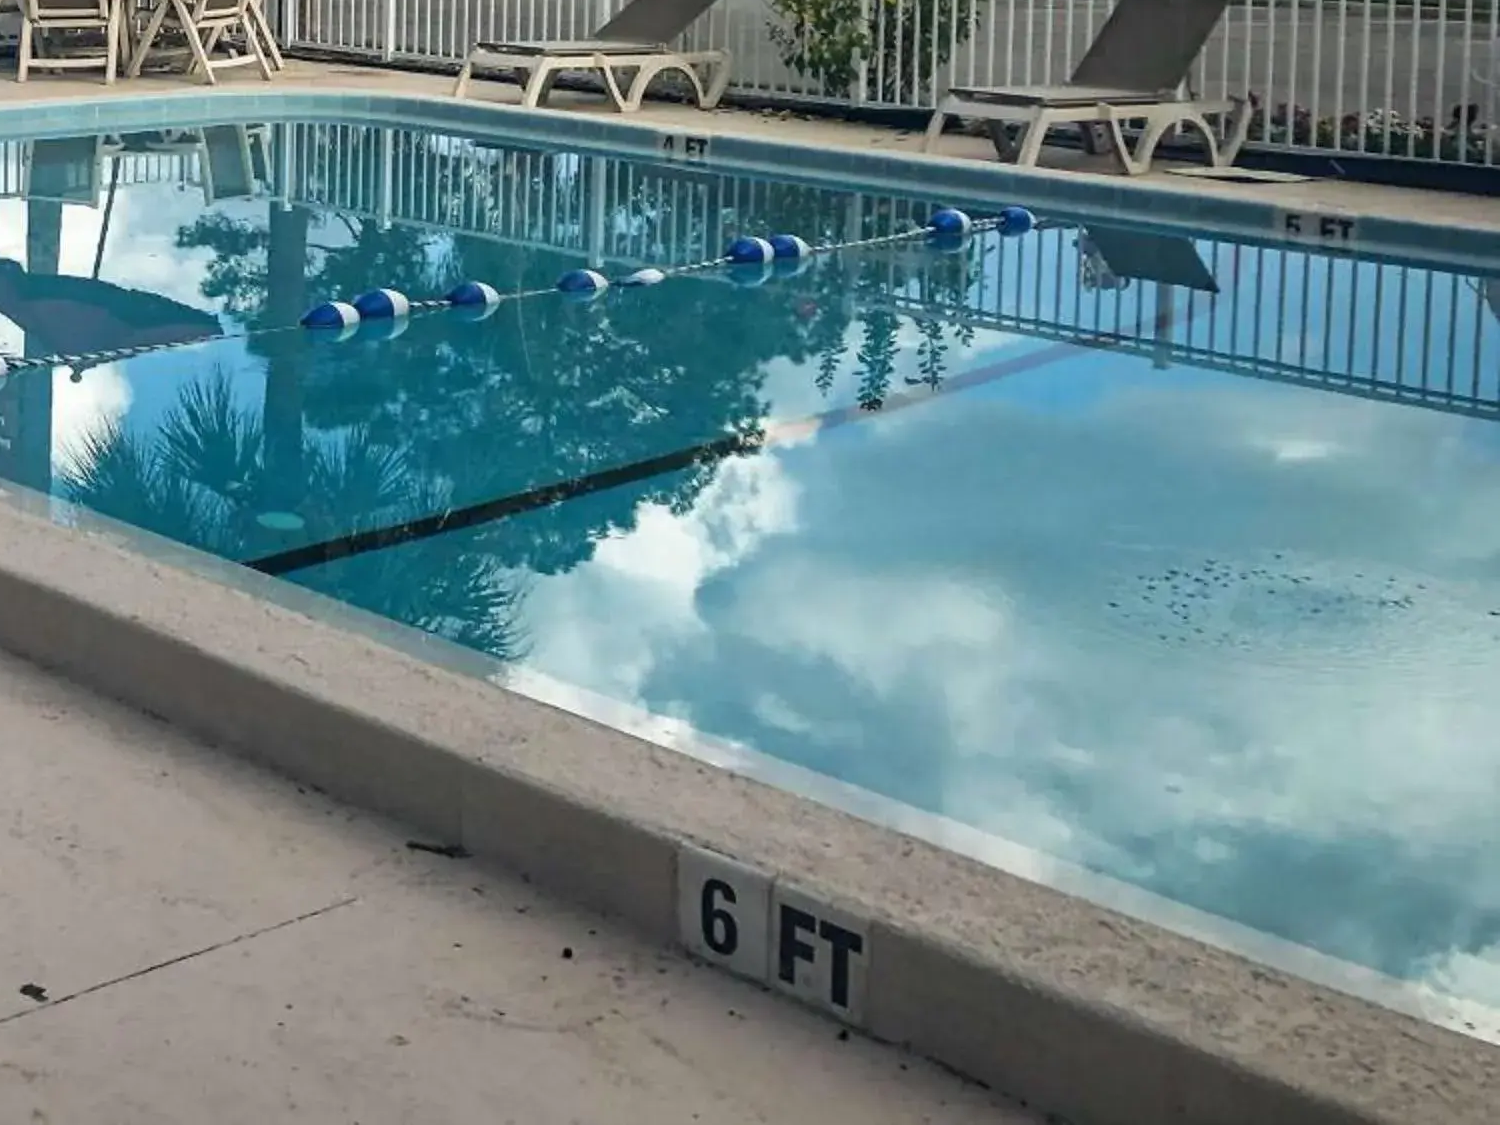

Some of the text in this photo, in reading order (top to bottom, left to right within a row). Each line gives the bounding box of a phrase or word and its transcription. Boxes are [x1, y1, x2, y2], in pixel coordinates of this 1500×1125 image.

[685, 137, 708, 154] FT
[1319, 217, 1355, 240] FT
[701, 877, 864, 1010] 6 FT
